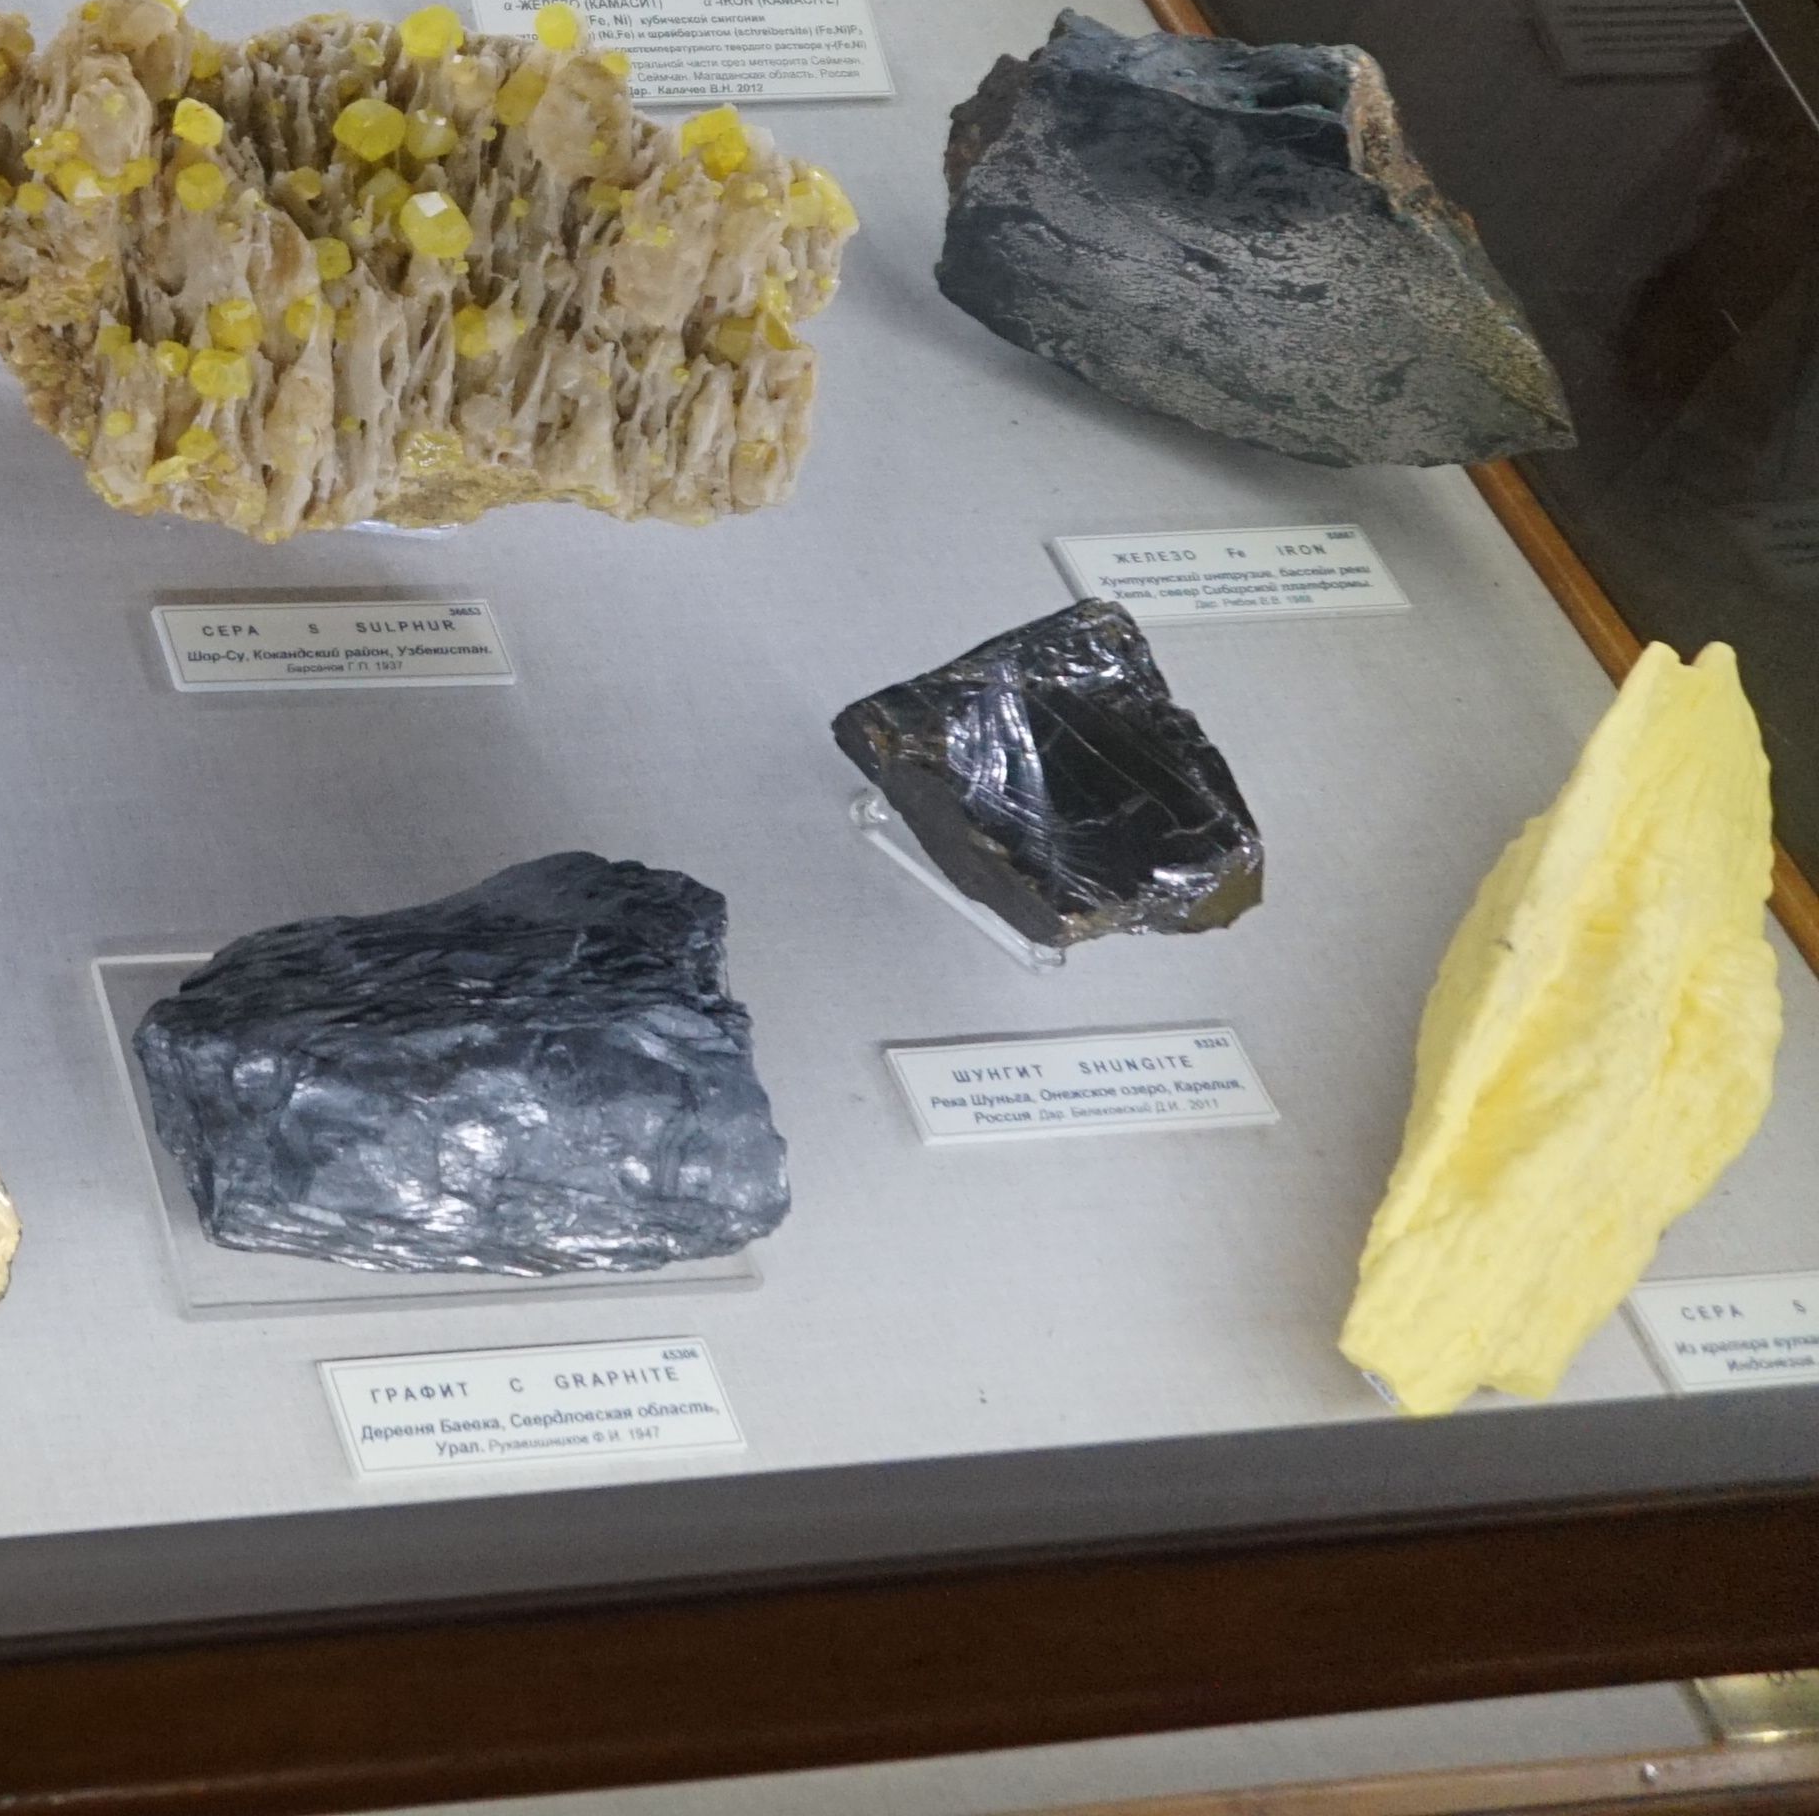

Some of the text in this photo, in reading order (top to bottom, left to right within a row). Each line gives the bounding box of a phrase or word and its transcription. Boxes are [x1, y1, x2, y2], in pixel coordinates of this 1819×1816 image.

[1112, 544, 1328, 564] ЖЕЛЕЗО Fe IRON
[202, 619, 456, 637] СЕРА S SULPHUR
[253, 647, 340, 661] Кокандский
[344, 648, 394, 659] район,
[396, 643, 492, 658] Узбекистан.
[951, 1055, 1194, 1084] ШУНГИТ SHUNGITE
[1039, 1087, 1117, 1101] Онежское
[1120, 1083, 1172, 1096] озеро,
[1681, 1299, 1807, 1321] СЕРА S
[370, 1381, 470, 1404] ГРАФИТ
[554, 1366, 681, 1390] GRAPHITE
[361, 1401, 720, 1444] Деревня Баевка, Свердловская область,
[435, 1440, 485, 1458] Урал.
